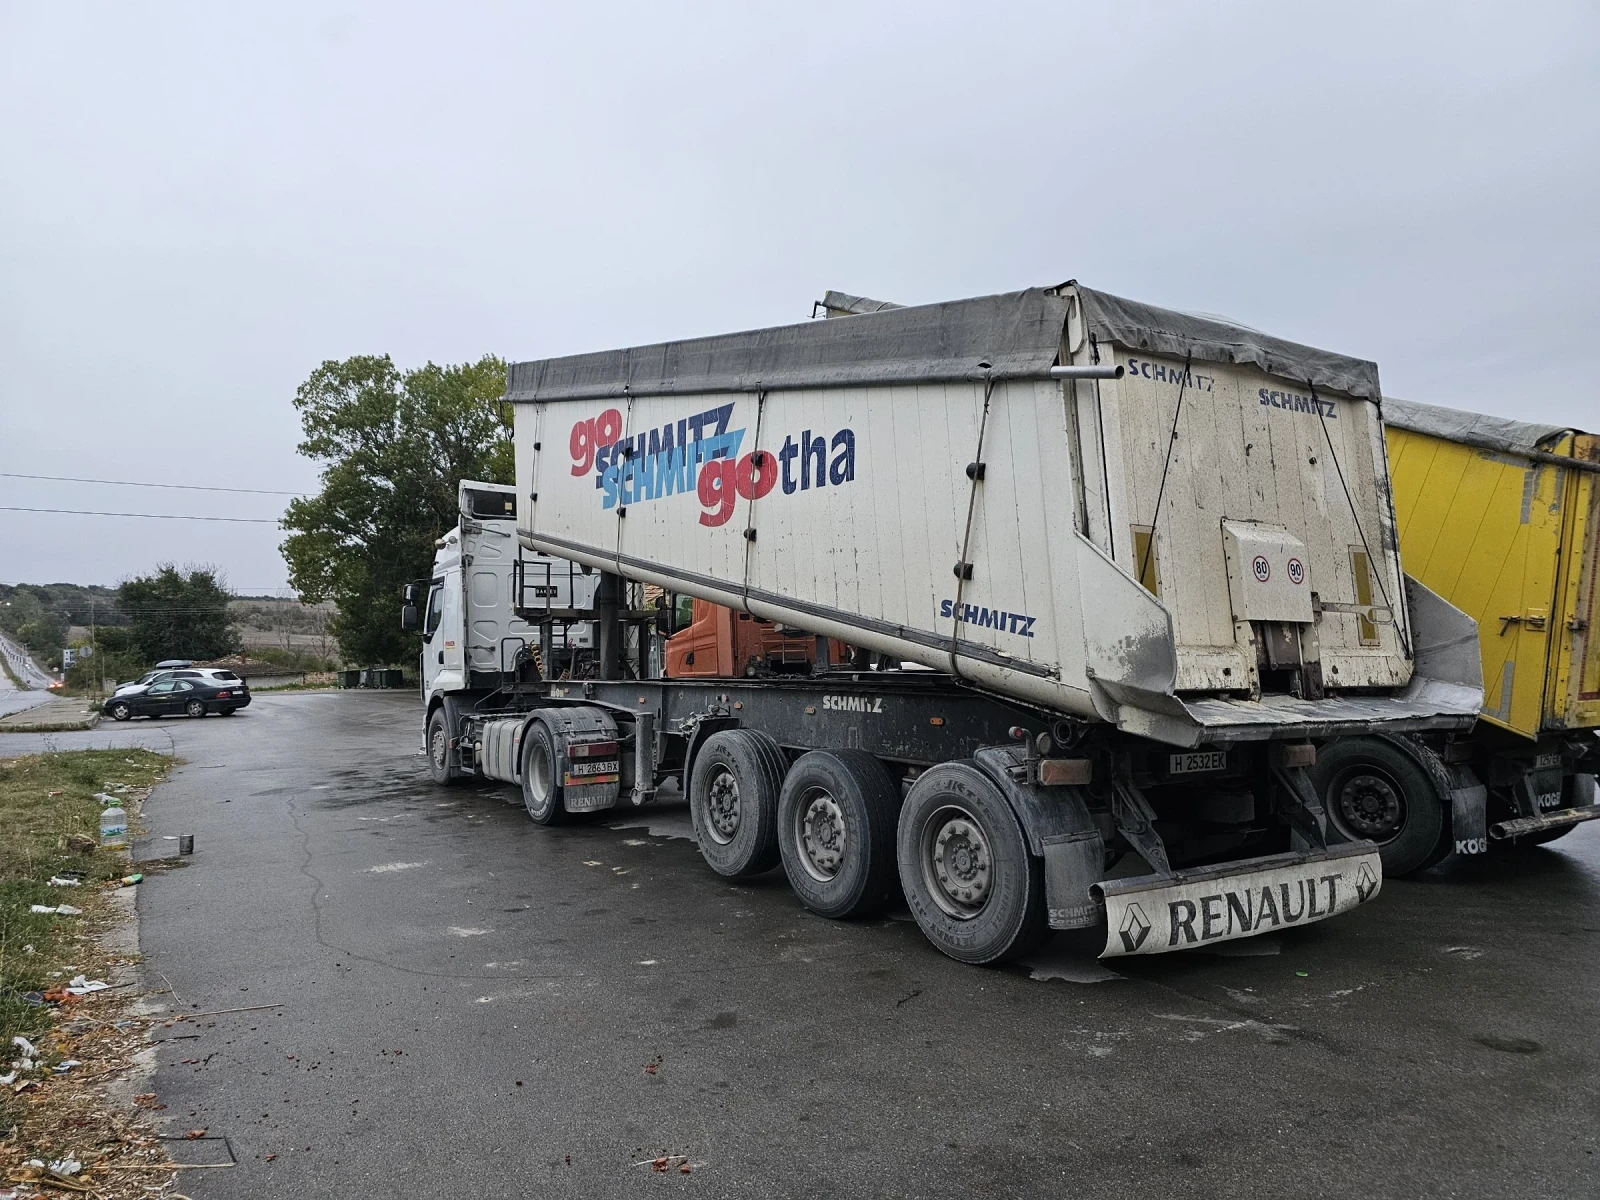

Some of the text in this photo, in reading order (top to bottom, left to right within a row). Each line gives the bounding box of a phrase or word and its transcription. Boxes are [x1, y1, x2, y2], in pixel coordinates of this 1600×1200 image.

[1258, 388, 1337, 418] SCHMITZ
[570, 408, 622, 476] go
[698, 428, 856, 527] gotha
[1256, 561, 1267, 574] 80
[1290, 563, 1301, 576] 90
[940, 599, 1037, 638] SCHMITZ
[578, 765, 584, 774] H
[1175, 755, 1182, 771] H
[570, 795, 613, 807] RENAULT
[1167, 872, 1342, 946] RENAULT
